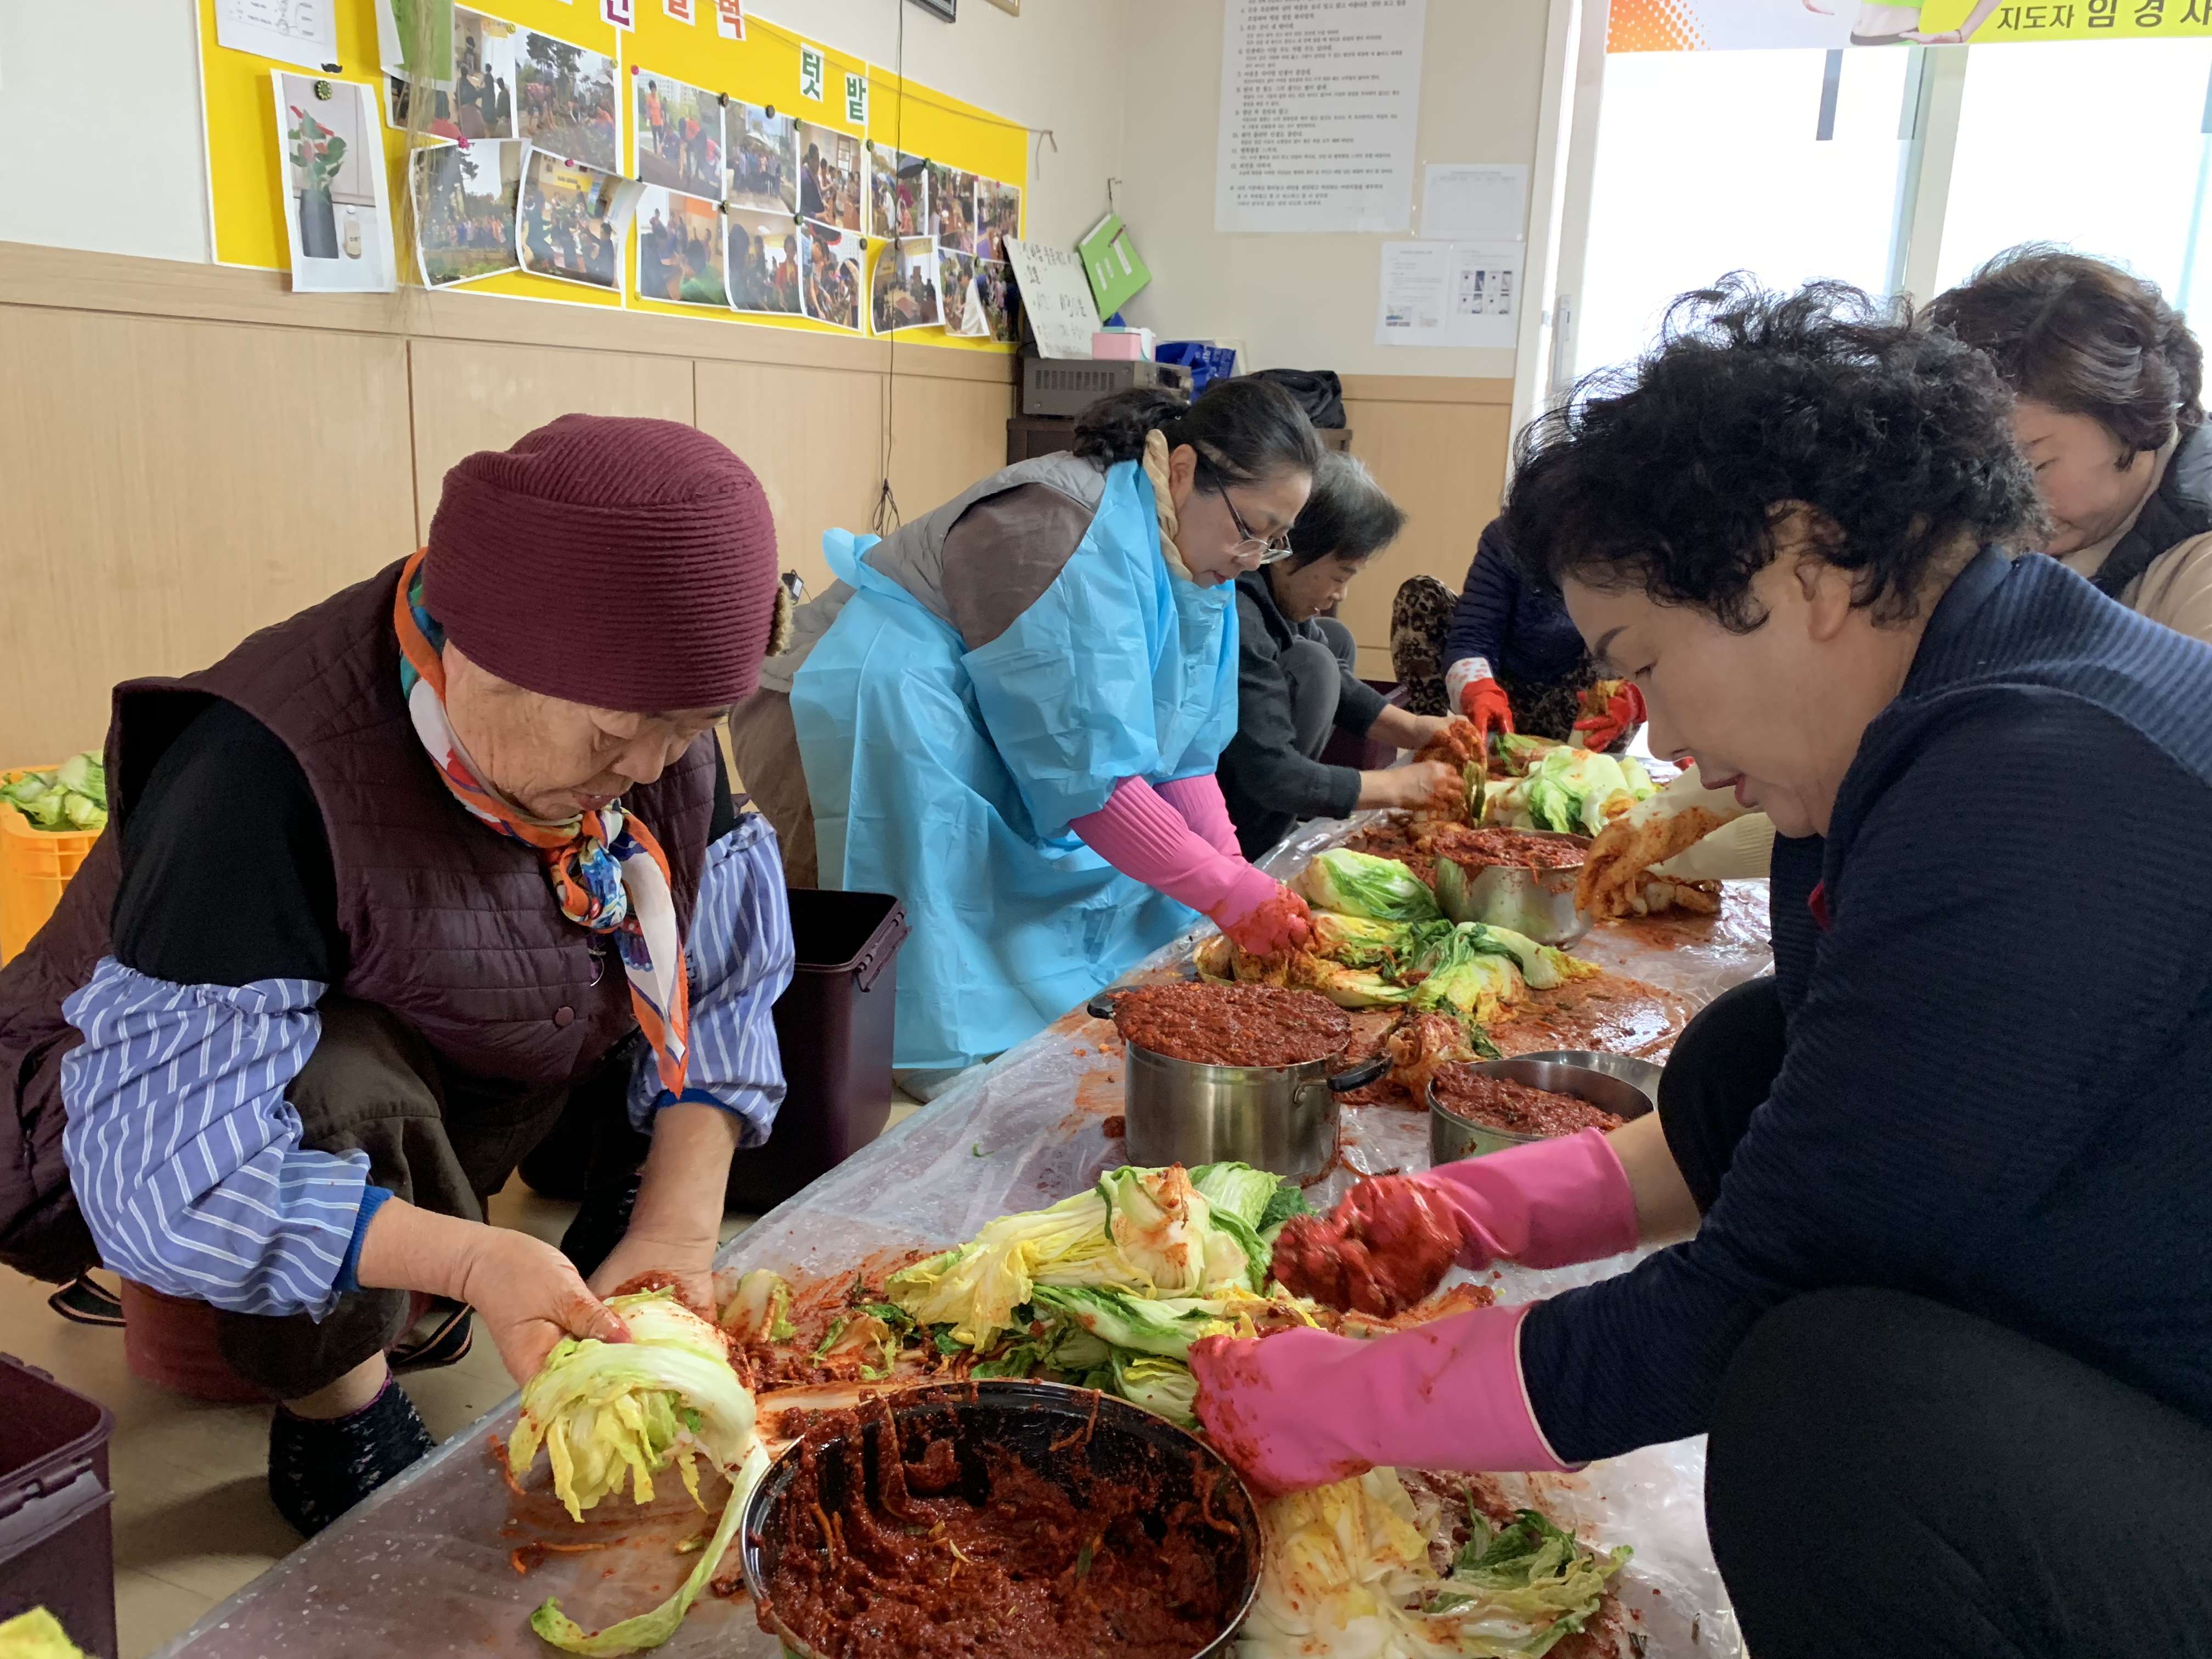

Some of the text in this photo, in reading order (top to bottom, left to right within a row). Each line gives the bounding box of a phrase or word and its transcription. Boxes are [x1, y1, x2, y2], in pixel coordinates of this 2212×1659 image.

[1997, 4, 2074, 30] 지도자
[2087, 0, 2117, 27] 임
[2134, 0, 2164, 27] 경
